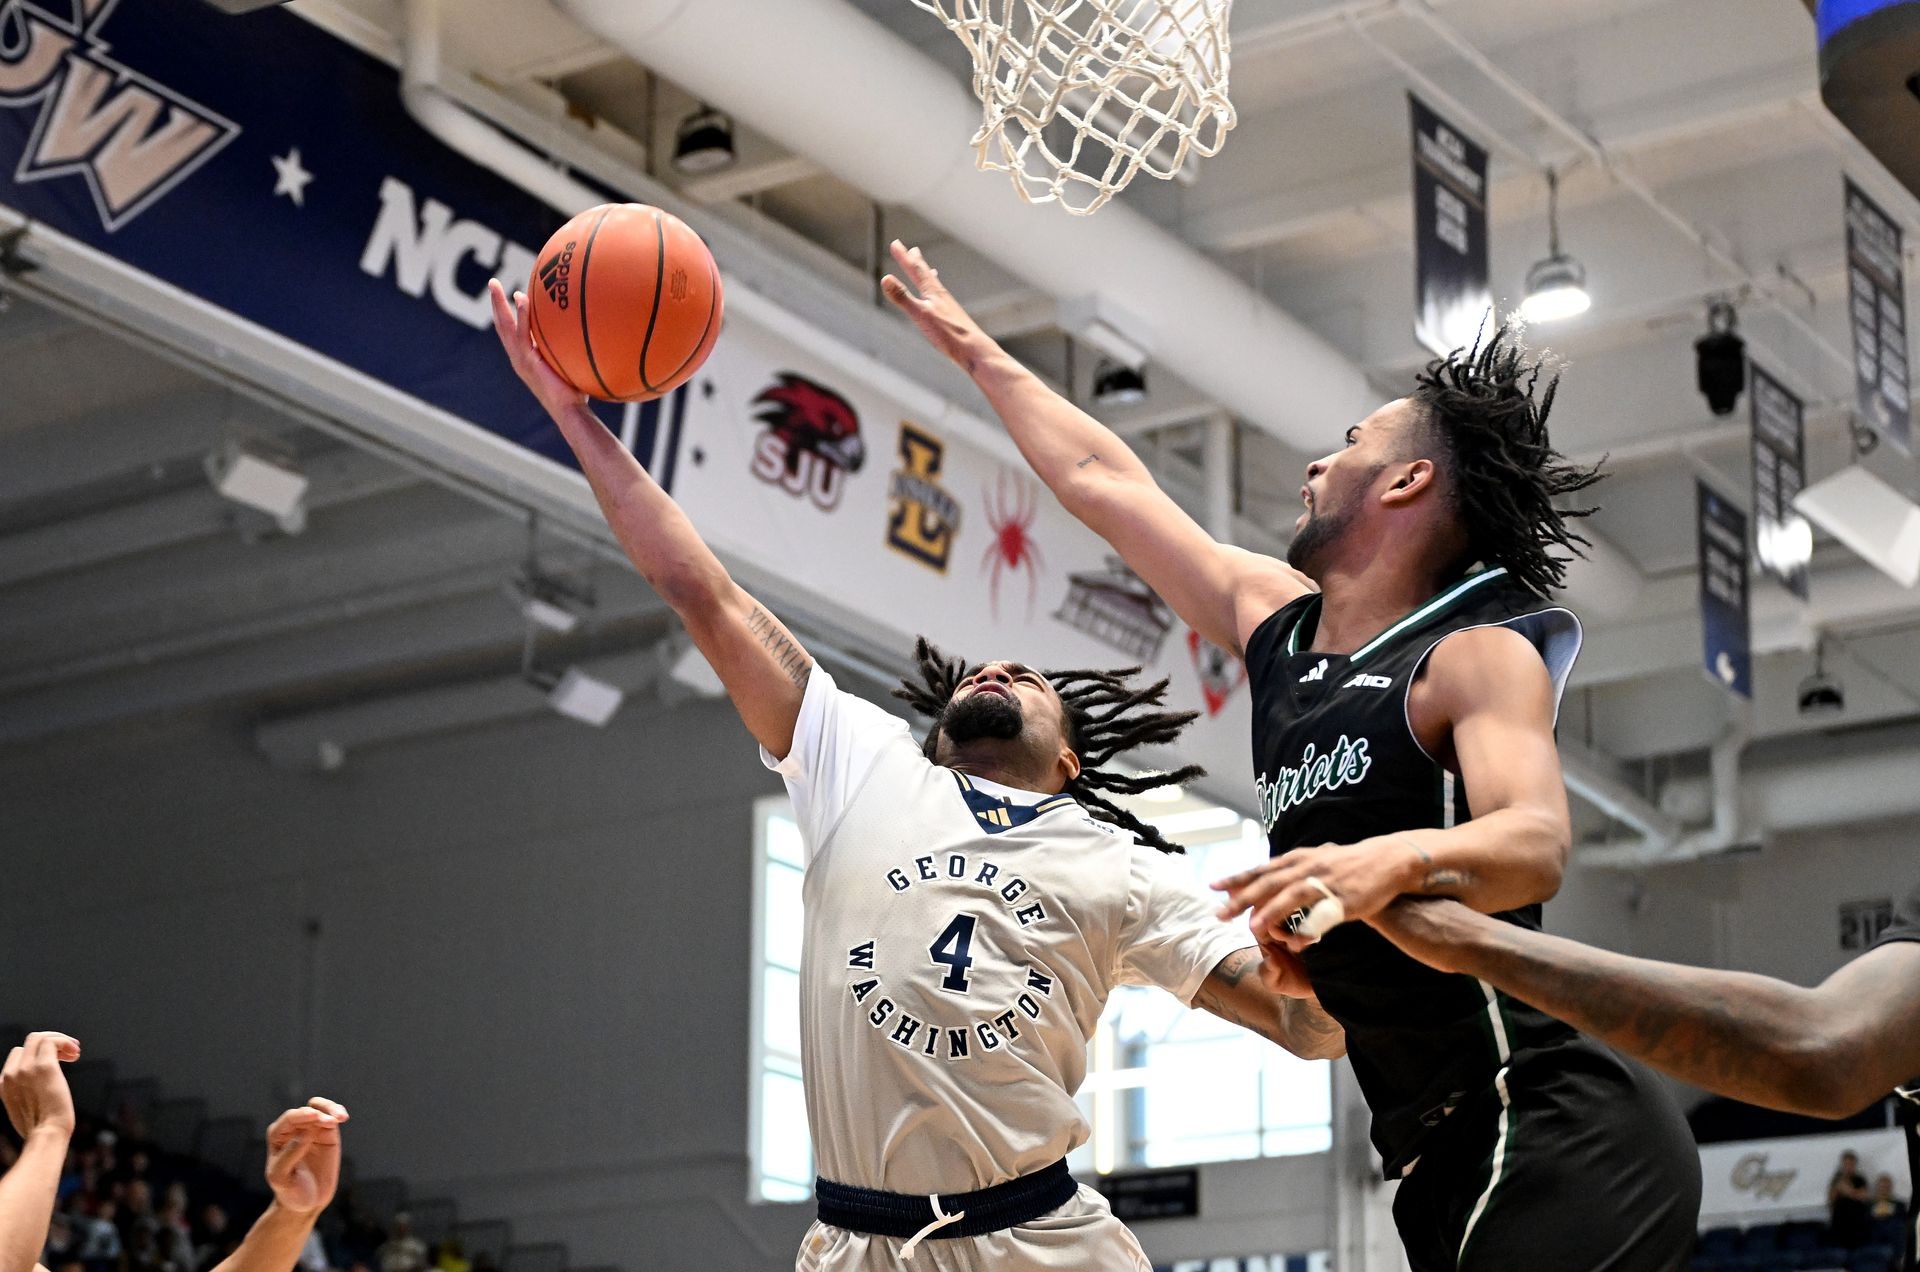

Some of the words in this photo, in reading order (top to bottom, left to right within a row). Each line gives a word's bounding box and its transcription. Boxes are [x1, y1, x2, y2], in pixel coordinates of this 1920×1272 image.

[558, 240, 577, 311] adidas
[752, 431, 846, 512] SJU
[884, 853, 1048, 927] GEORGE
[927, 911, 979, 995] 4
[847, 938, 1055, 1060] WASHINGTON
